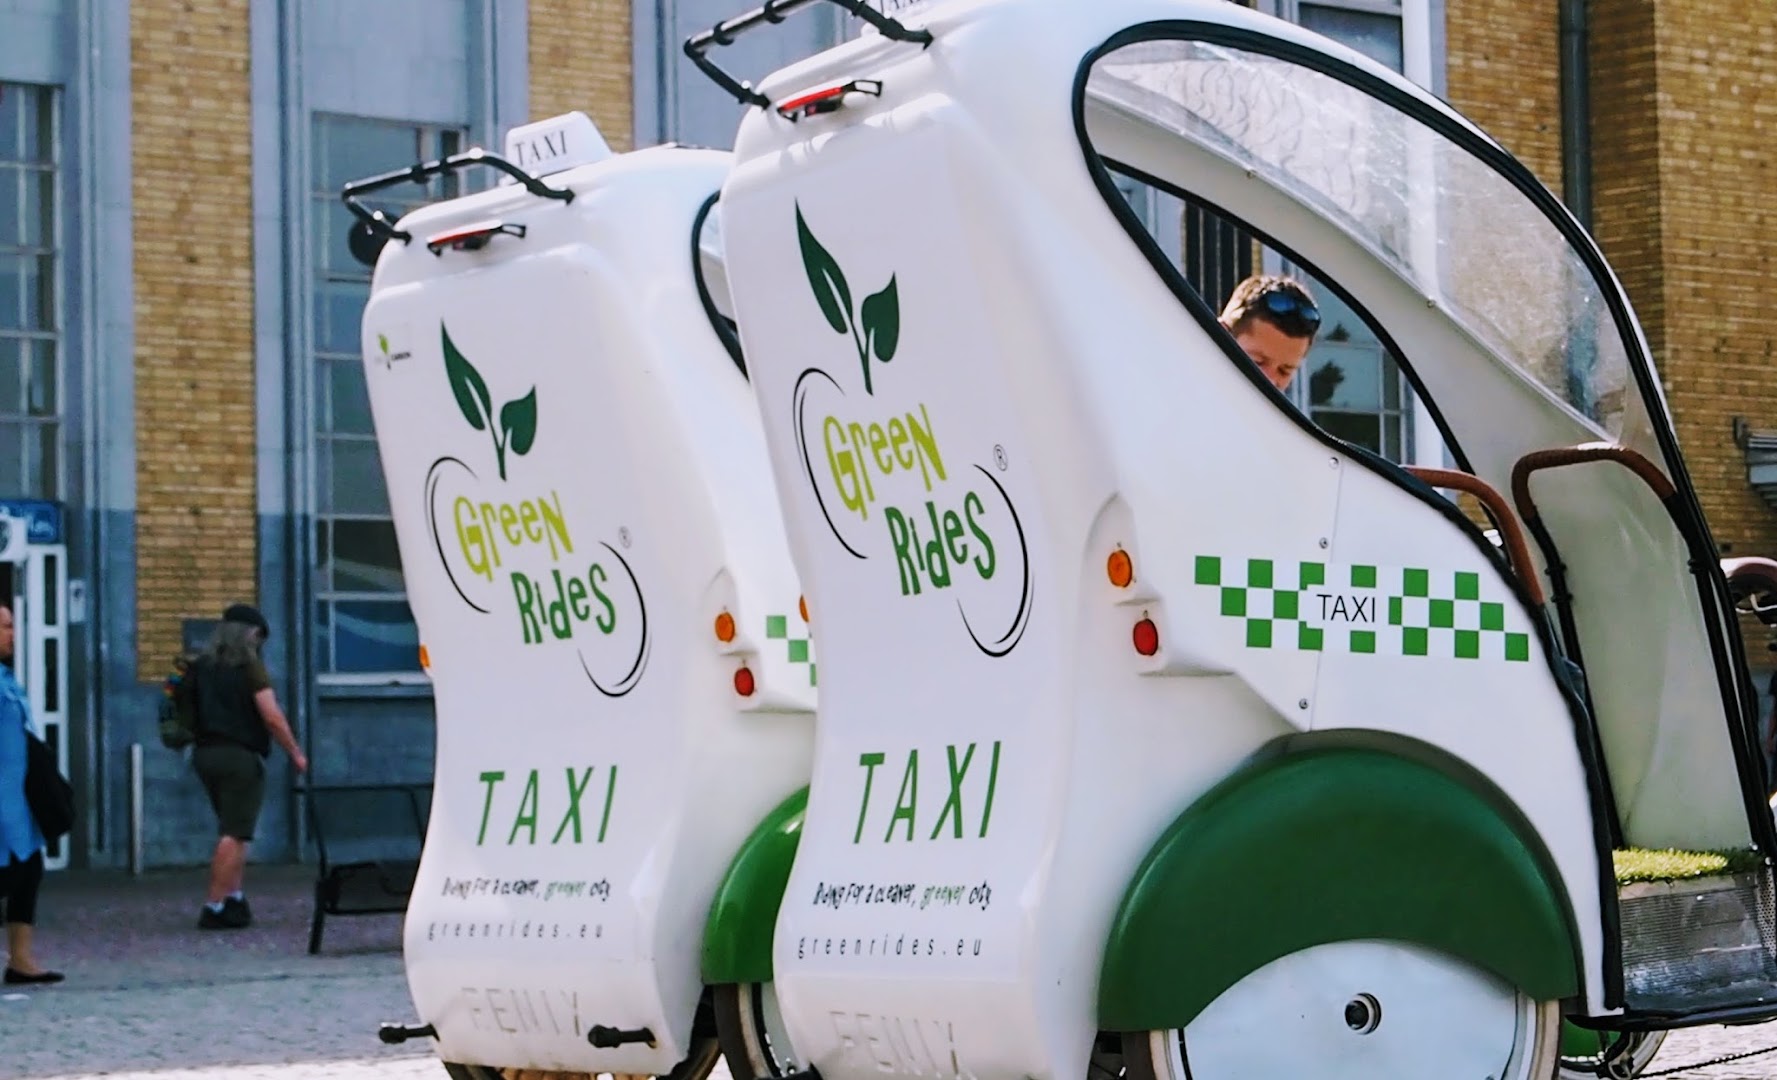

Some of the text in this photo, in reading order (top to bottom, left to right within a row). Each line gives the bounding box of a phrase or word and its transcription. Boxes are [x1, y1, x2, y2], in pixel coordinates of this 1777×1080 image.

[514, 130, 567, 167] TAXI
[1316, 594, 1376, 623] TAXI
[476, 764, 618, 846] TAXI
[853, 740, 1002, 845] TAXI
[798, 930, 983, 960] greenrides.eu
